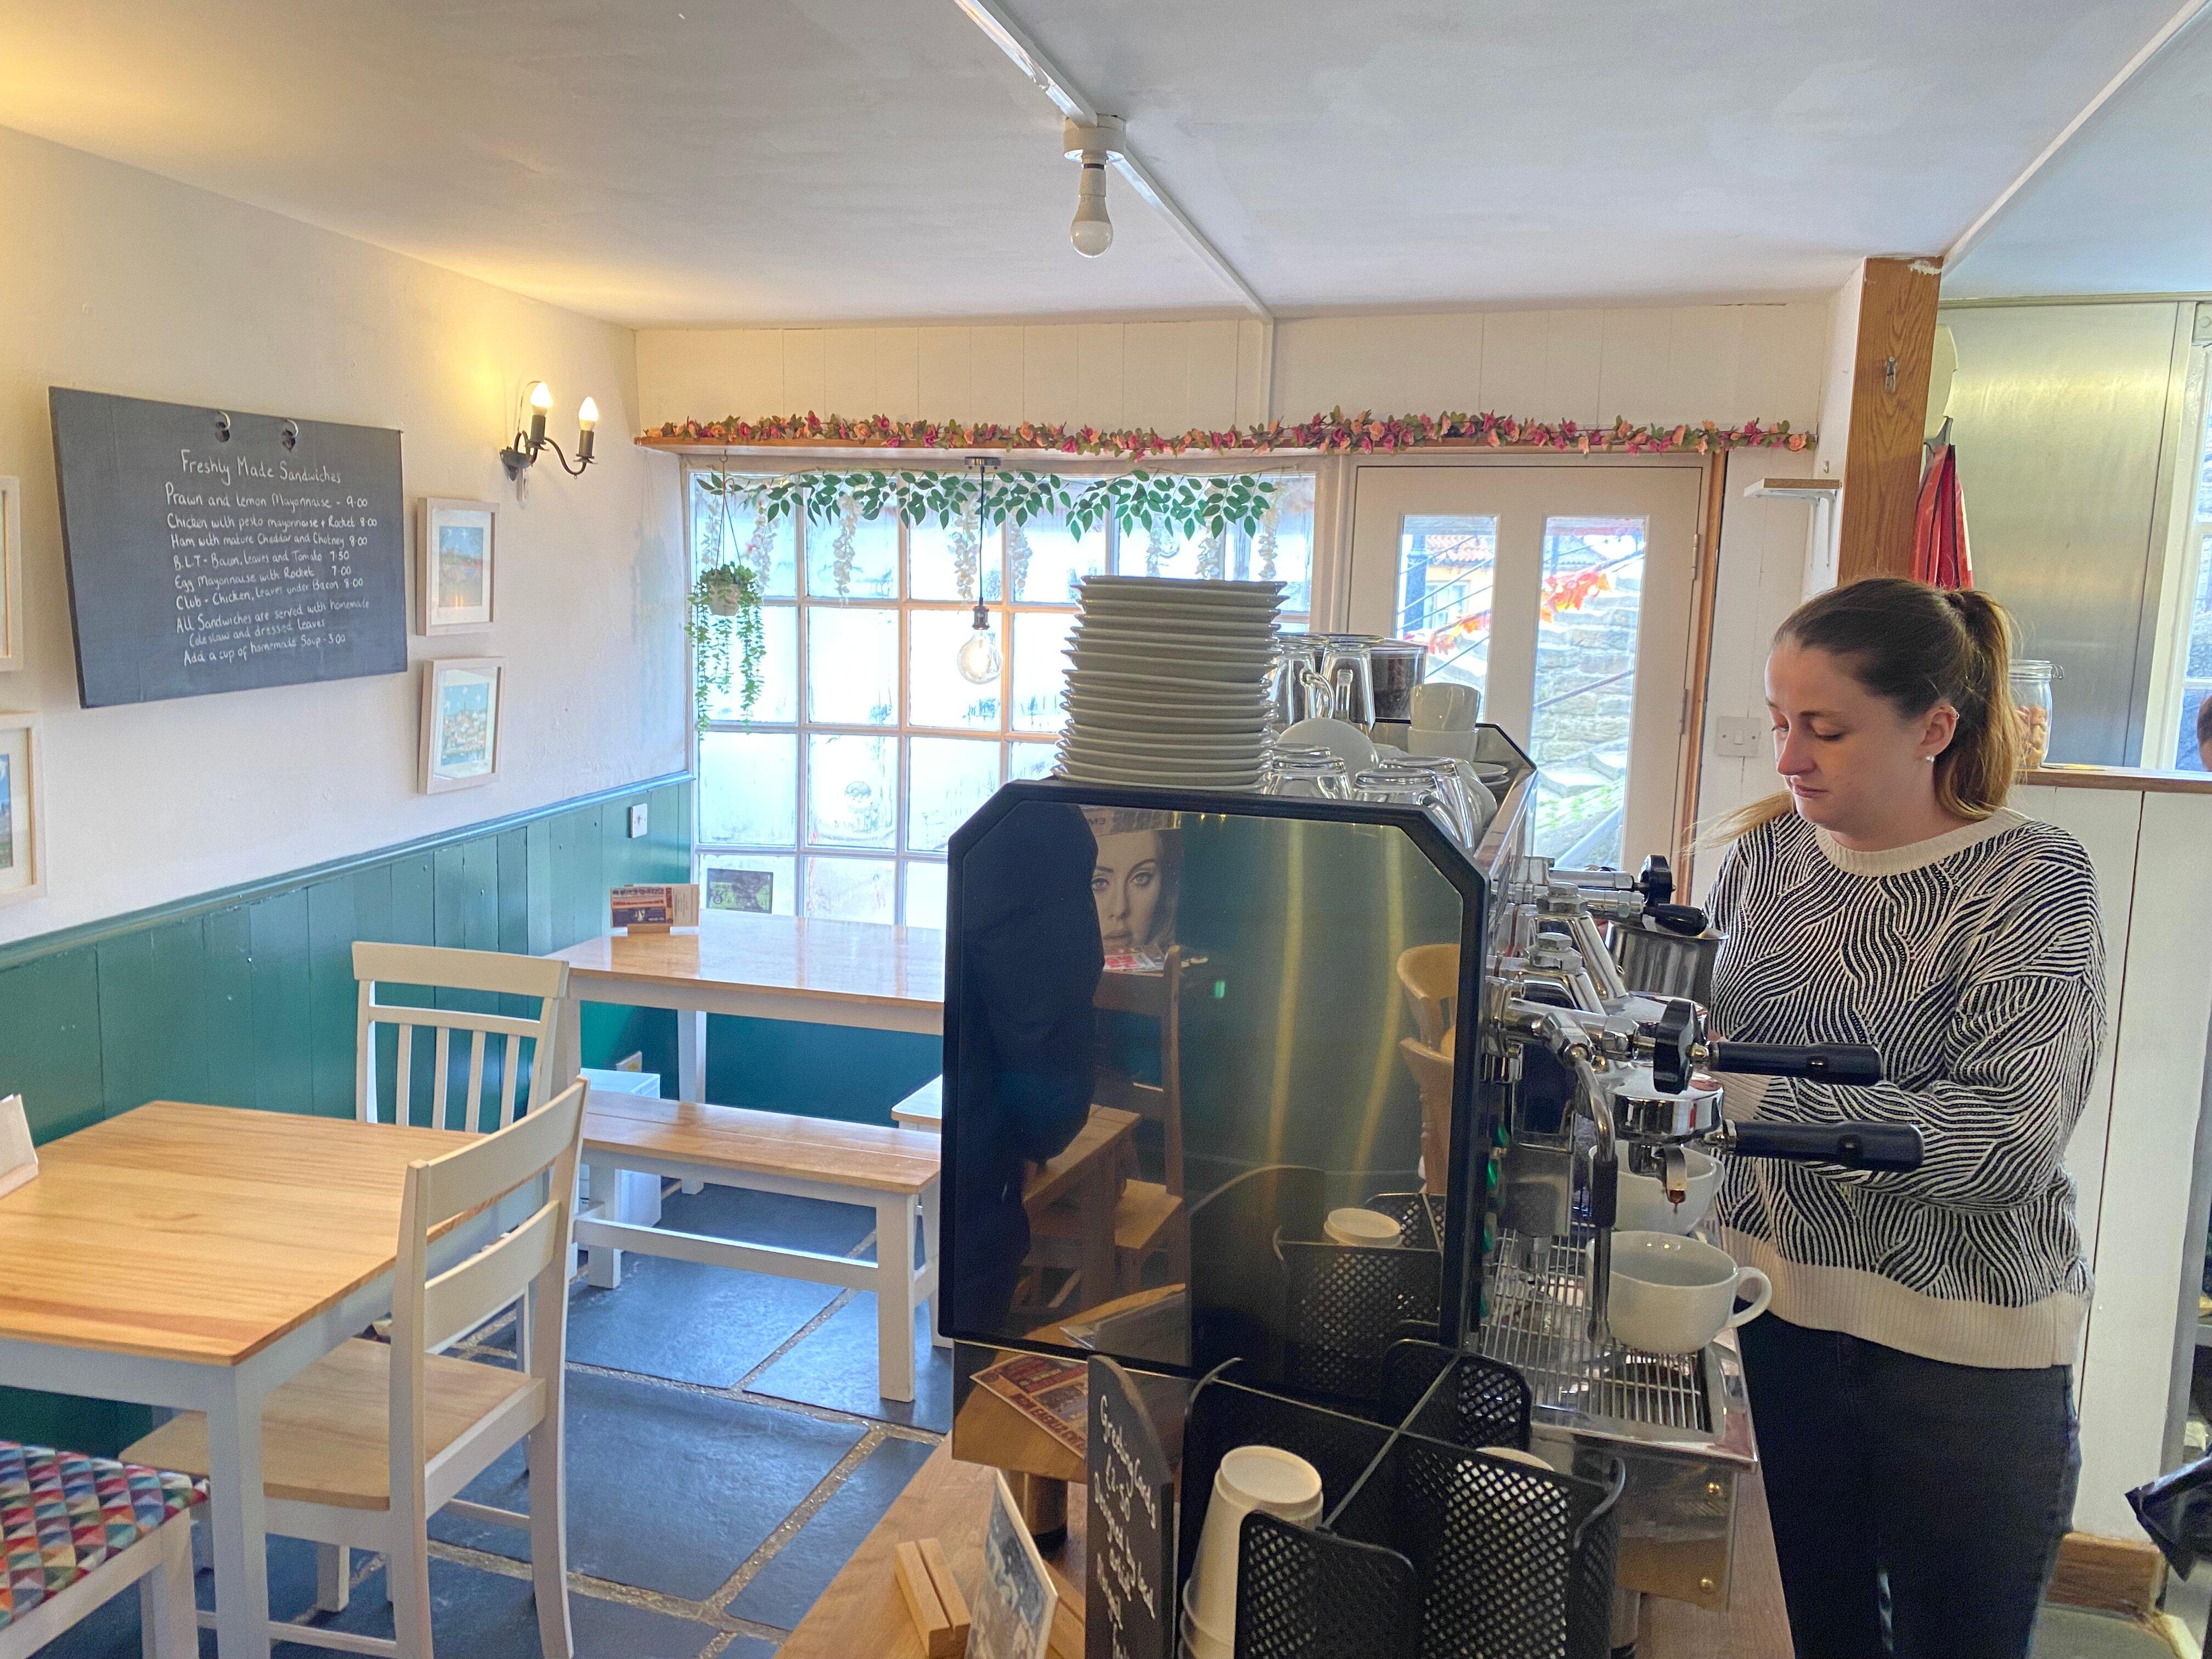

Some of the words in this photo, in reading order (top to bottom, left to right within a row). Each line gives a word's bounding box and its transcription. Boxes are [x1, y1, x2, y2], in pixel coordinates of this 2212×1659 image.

[180, 449, 230, 487] Freshly
[237, 455, 274, 477] Made
[280, 460, 340, 484] Sandwiches
[165, 481, 203, 505] Prawn
[208, 494, 230, 507] and
[236, 492, 266, 507] lemon
[272, 492, 331, 513] Mayonnaise
[167, 512, 207, 529] Chicken
[211, 515, 235, 528] with
[239, 514, 263, 531] pesto
[268, 518, 318, 533] mayonnaise
[329, 515, 355, 528] Rocket
[171, 533, 195, 549] Ham
[198, 532, 219, 546] with
[223, 533, 253, 545] mature
[257, 532, 291, 545] Cheddar
[294, 533, 311, 543] and
[272, 550, 290, 562] and
[291, 549, 322, 562] Tomato
[175, 575, 194, 592] Egg
[198, 574, 257, 590] Mayonnaise
[259, 568, 280, 582] with
[284, 565, 314, 579] Rocket
[176, 595, 201, 610] Club
[212, 589, 254, 605] Chicken,
[287, 583, 308, 594] under
[312, 578, 339, 591] Bacon
[177, 616, 195, 633] All
[198, 612, 251, 631] Sandwiches
[255, 612, 269, 622] are
[274, 604, 303, 619] served
[307, 601, 326, 613] with
[330, 597, 369, 610] homemade
[233, 626, 251, 639] and
[255, 620, 293, 637] dressed
[184, 650, 205, 666] Add
[209, 652, 216, 661] a
[219, 650, 235, 663] cup
[238, 645, 247, 661] of
[250, 637, 296, 653] homemade
[301, 634, 321, 648] Soup
